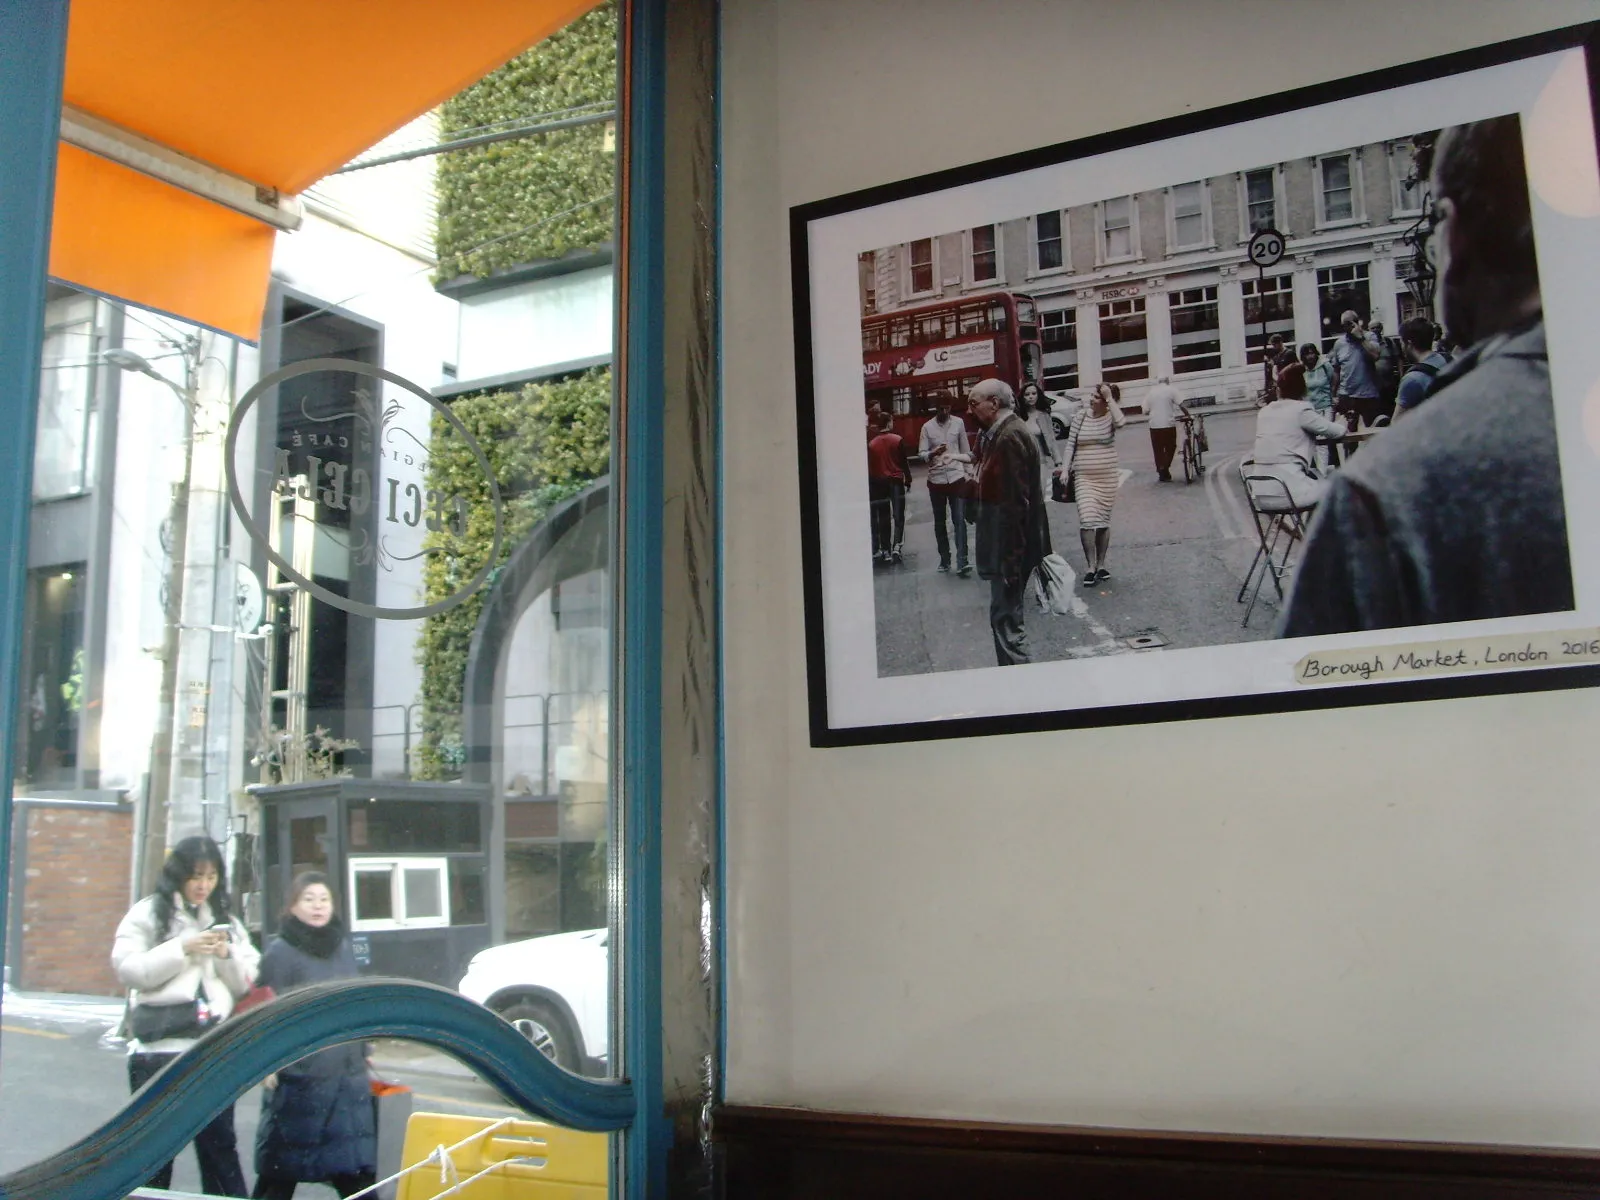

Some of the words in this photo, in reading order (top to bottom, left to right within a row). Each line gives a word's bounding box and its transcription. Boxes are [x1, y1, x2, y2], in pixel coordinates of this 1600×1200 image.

[1254, 240, 1281, 258] 20
[1102, 288, 1126, 300] HSBC
[1302, 655, 1383, 680] Borough
[1484, 643, 1548, 663] London
[1561, 639, 1600, 656] 2016
